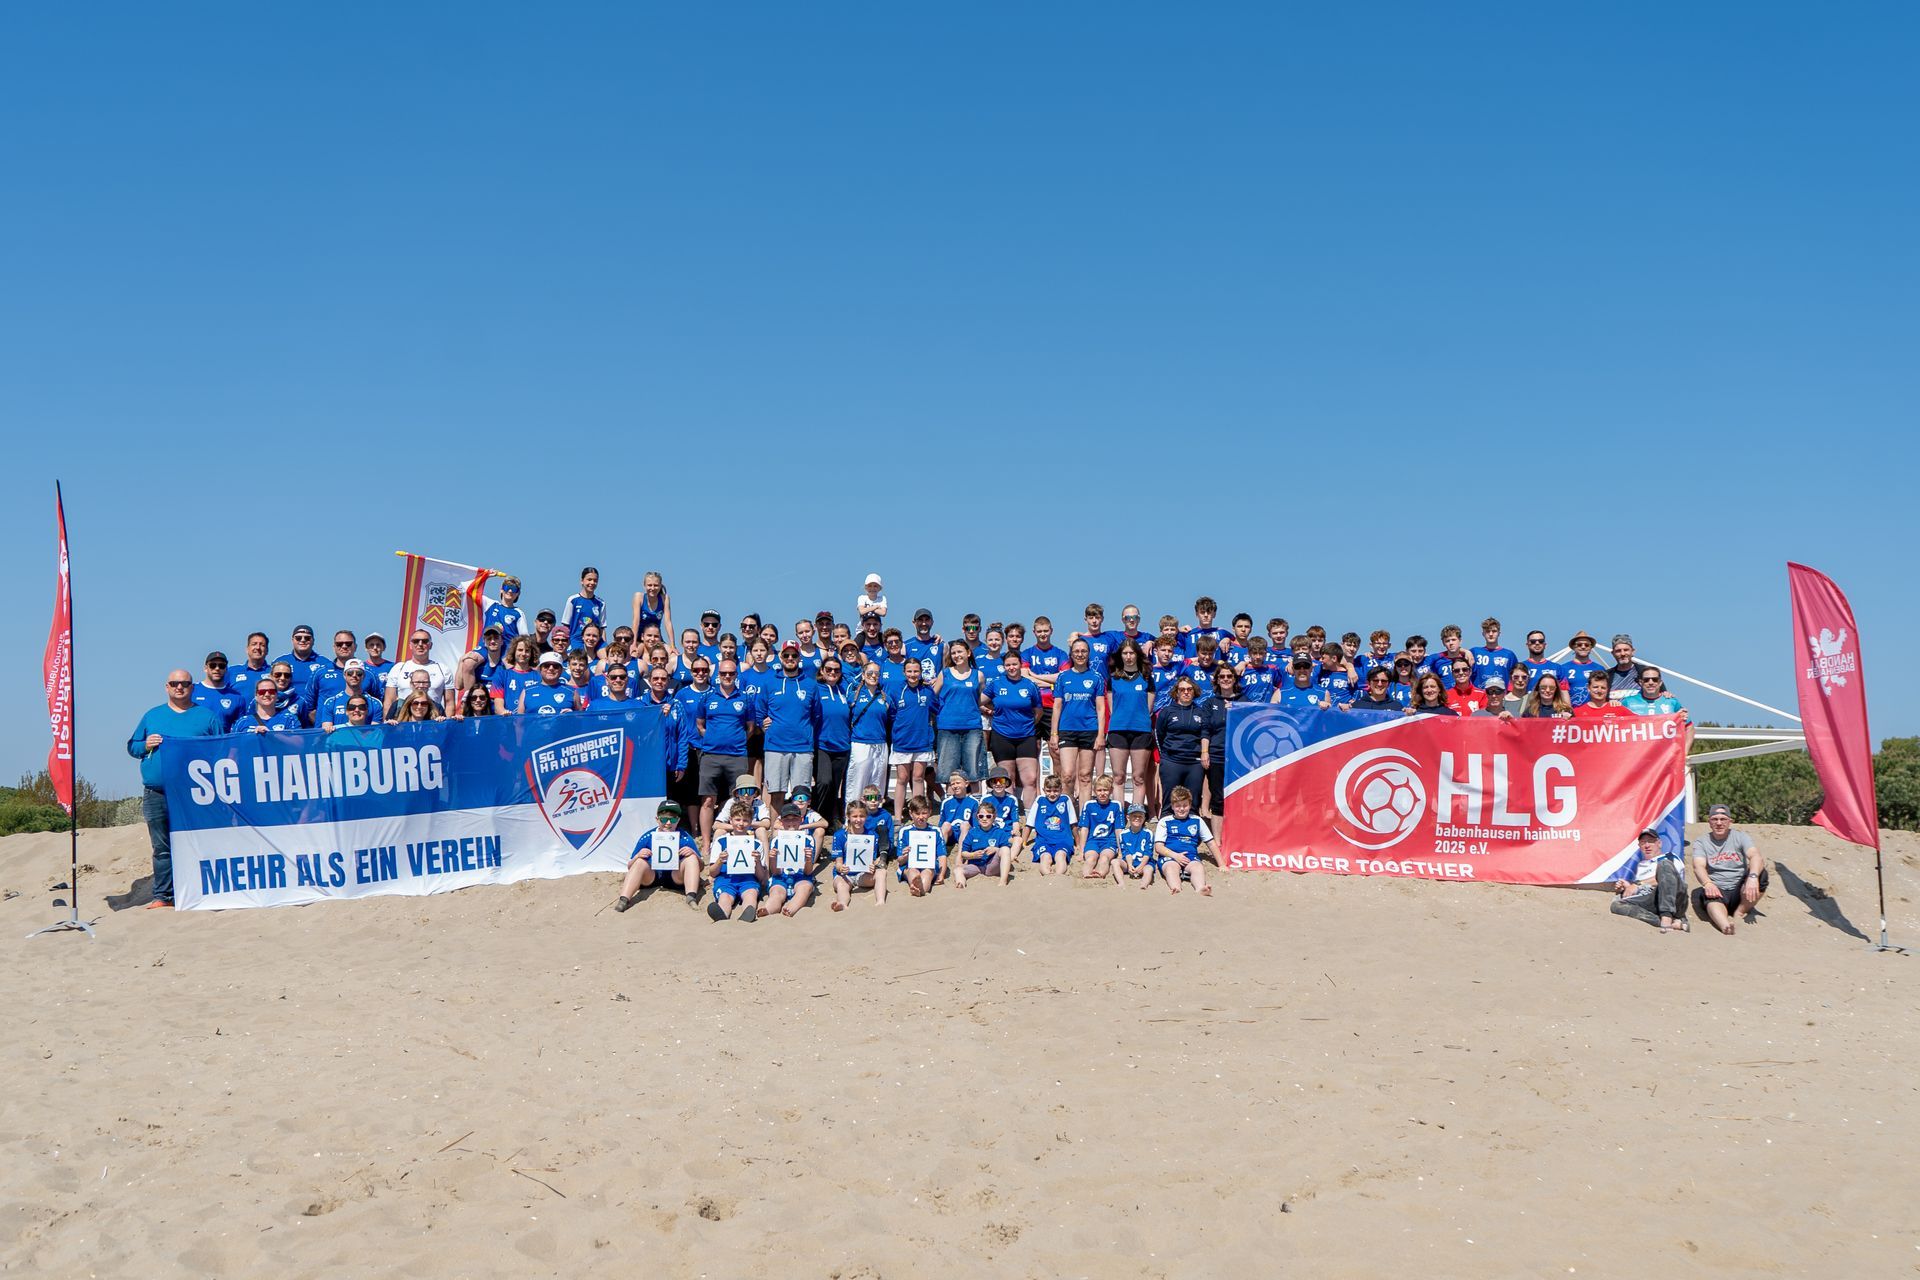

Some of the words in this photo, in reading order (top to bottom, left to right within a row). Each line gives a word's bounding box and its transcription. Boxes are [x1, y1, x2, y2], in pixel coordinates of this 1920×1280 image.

[1227, 653, 1238, 663] 24
[1476, 655, 1489, 666] 30
[1193, 670, 1206, 681] 83
[1244, 674, 1256, 685] 28
[1568, 669, 1576, 679] 2
[508, 679, 516, 691] 4
[601, 685, 609, 697] 8
[1552, 719, 1677, 744] #DuWirHLG
[539, 750, 555, 764] SG
[561, 734, 618, 758] HAINBURG
[540, 745, 618, 774] HANDBALL
[188, 759, 241, 806] SG
[253, 745, 443, 803] HAINBURG
[1437, 751, 1578, 827] HLG
[963, 808, 971, 820] 6
[1002, 806, 1010, 818] 2
[1106, 811, 1114, 823] 4
[1435, 824, 1520, 840] babenhausen
[1524, 827, 1581, 841] hainburg
[658, 845, 673, 864] D
[783, 844, 799, 862] N
[916, 844, 928, 862] E
[1434, 840, 1465, 854] 2025
[1469, 842, 1490, 855] e.V.
[199, 853, 287, 896] MEHR
[296, 851, 346, 888] ALS
[354, 845, 398, 884] EIN
[406, 835, 501, 877] VEREIN
[733, 849, 749, 868] A
[853, 848, 867, 866] K
[1229, 851, 1350, 872] STRONGER
[1355, 859, 1474, 878] TOGETHER
